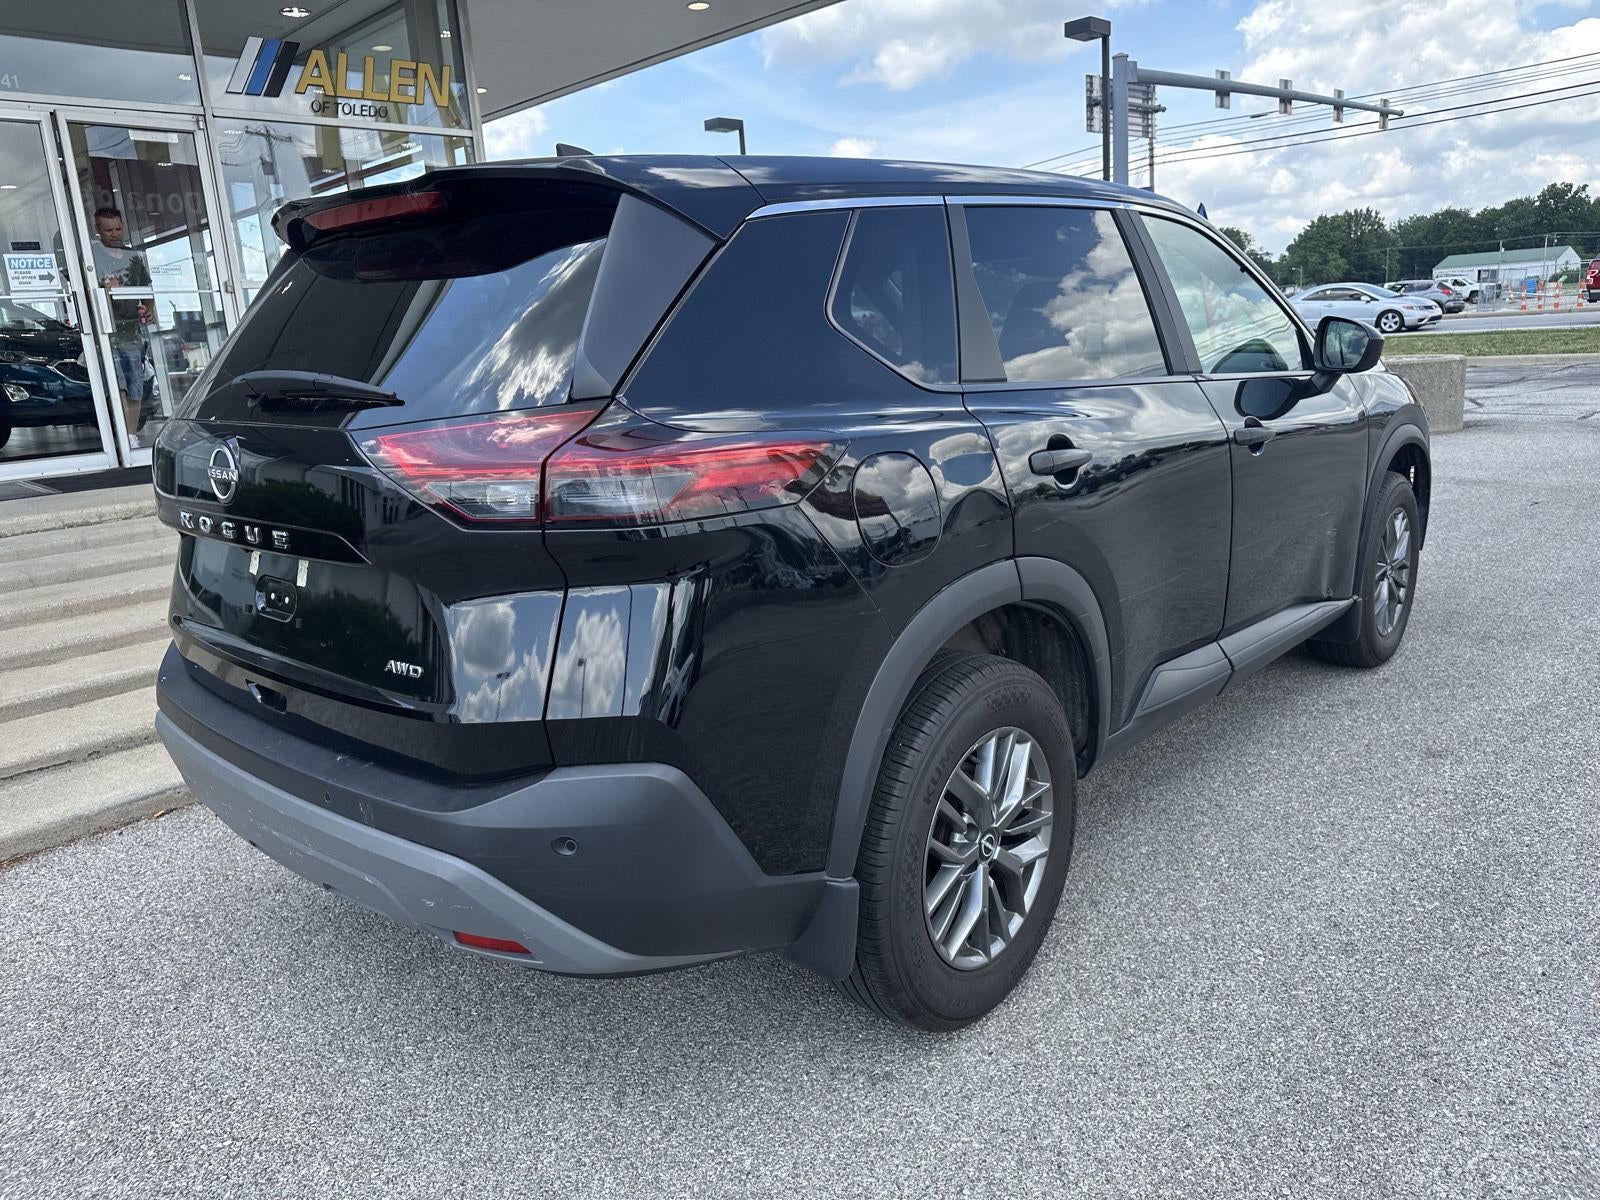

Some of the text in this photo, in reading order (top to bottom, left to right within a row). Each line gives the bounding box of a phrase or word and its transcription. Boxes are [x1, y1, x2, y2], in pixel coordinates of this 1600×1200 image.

[295, 49, 450, 107] ALLEN
[311, 99, 388, 118] OF TOLEDO
[10, 258, 52, 269] NOTICE
[208, 468, 238, 481] ISSAN
[180, 511, 290, 550] ROGUE
[384, 659, 424, 679] AWD
